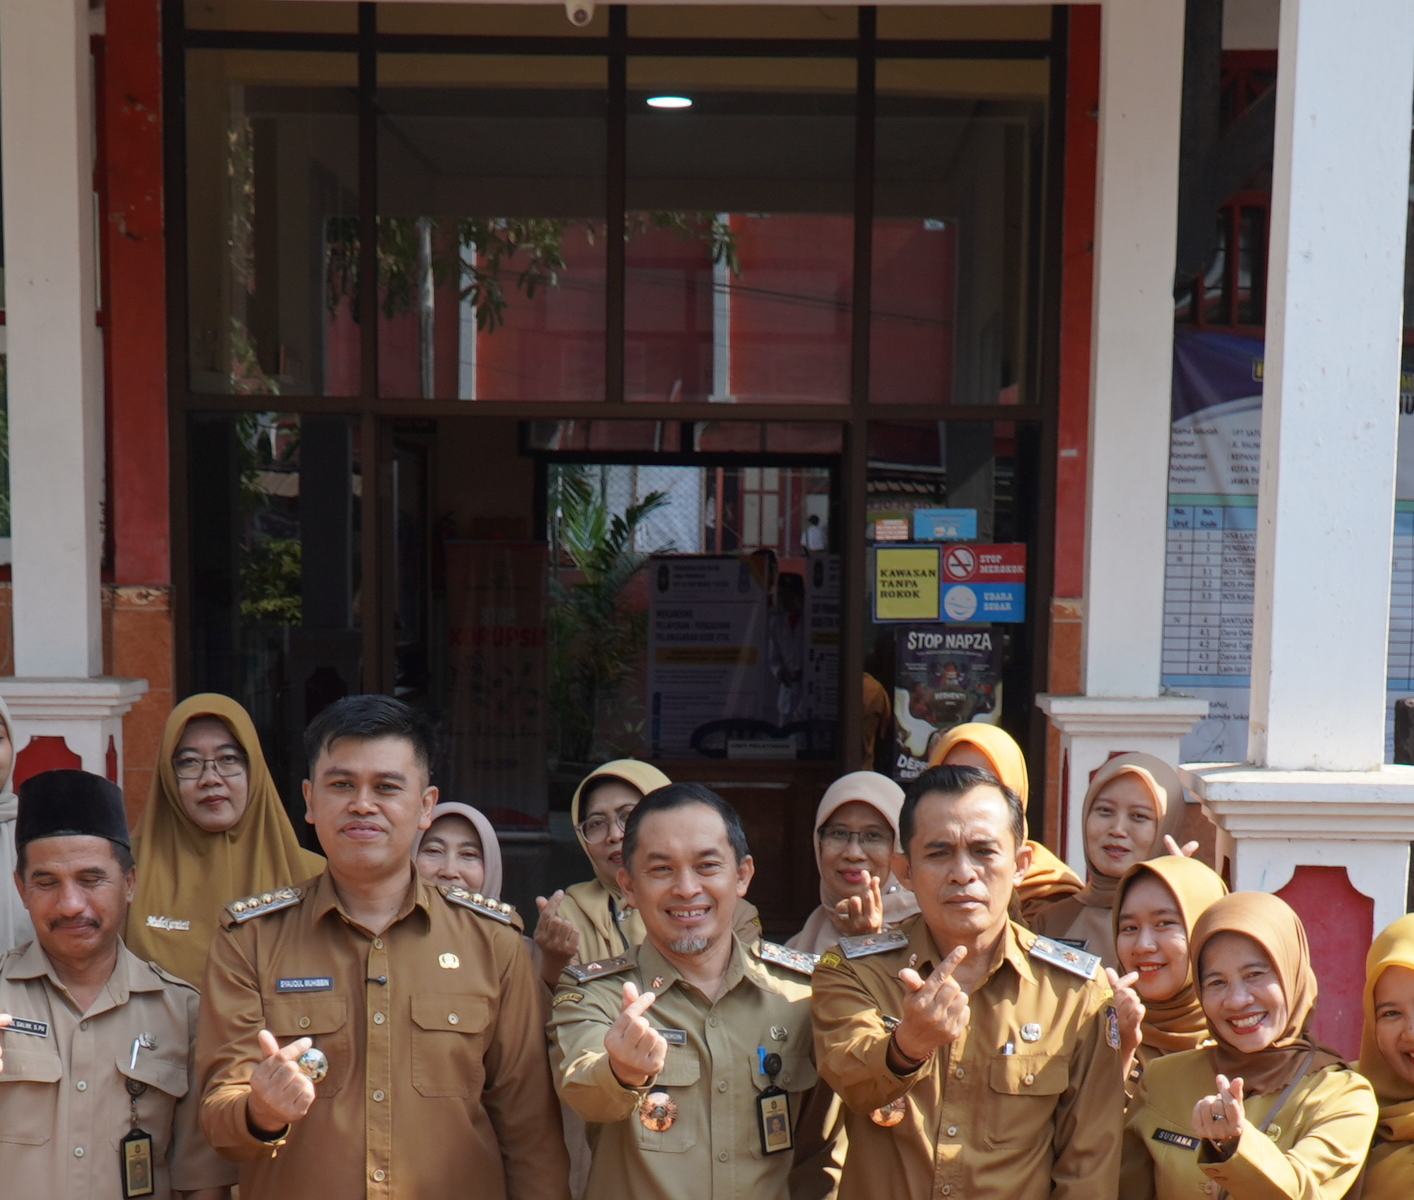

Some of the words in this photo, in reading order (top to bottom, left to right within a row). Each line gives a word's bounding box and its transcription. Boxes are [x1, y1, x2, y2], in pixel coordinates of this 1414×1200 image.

[979, 554, 1002, 563] STOP
[880, 569, 937, 578] KAWASAN
[979, 565, 1025, 574] MEROKOK
[880, 580, 918, 588] TANPA
[880, 590, 921, 599] ROKOK
[907, 631, 944, 650] STOP
[945, 633, 993, 651] NAPZA
[1158, 1131, 1193, 1147] SUSIANA
